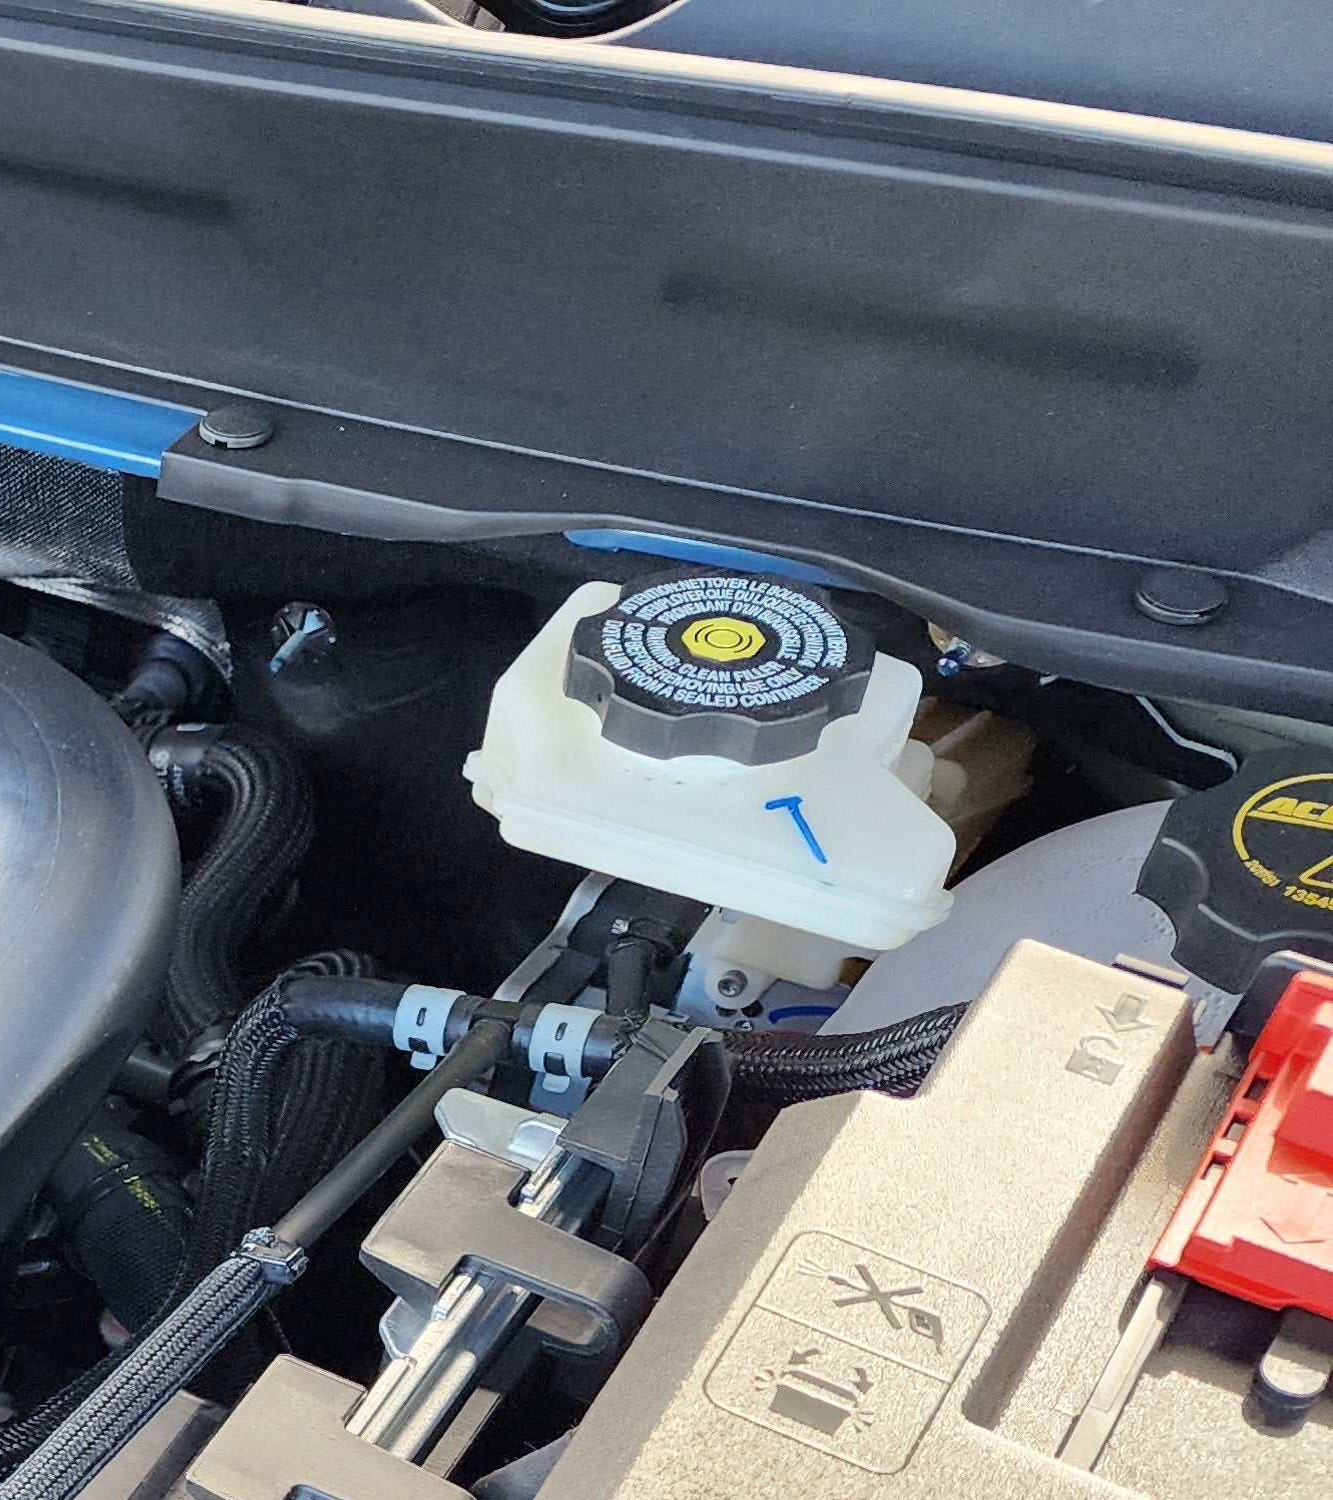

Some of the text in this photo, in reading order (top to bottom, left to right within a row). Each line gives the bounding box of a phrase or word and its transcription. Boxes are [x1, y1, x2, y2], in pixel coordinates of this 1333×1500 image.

[705, 588, 735, 600] QUE
[748, 580, 770, 594] LE
[677, 662, 731, 683] CLEAN
[732, 660, 786, 683] FILLER
[761, 666, 804, 689] ONLY
[673, 688, 739, 707] SEALED
